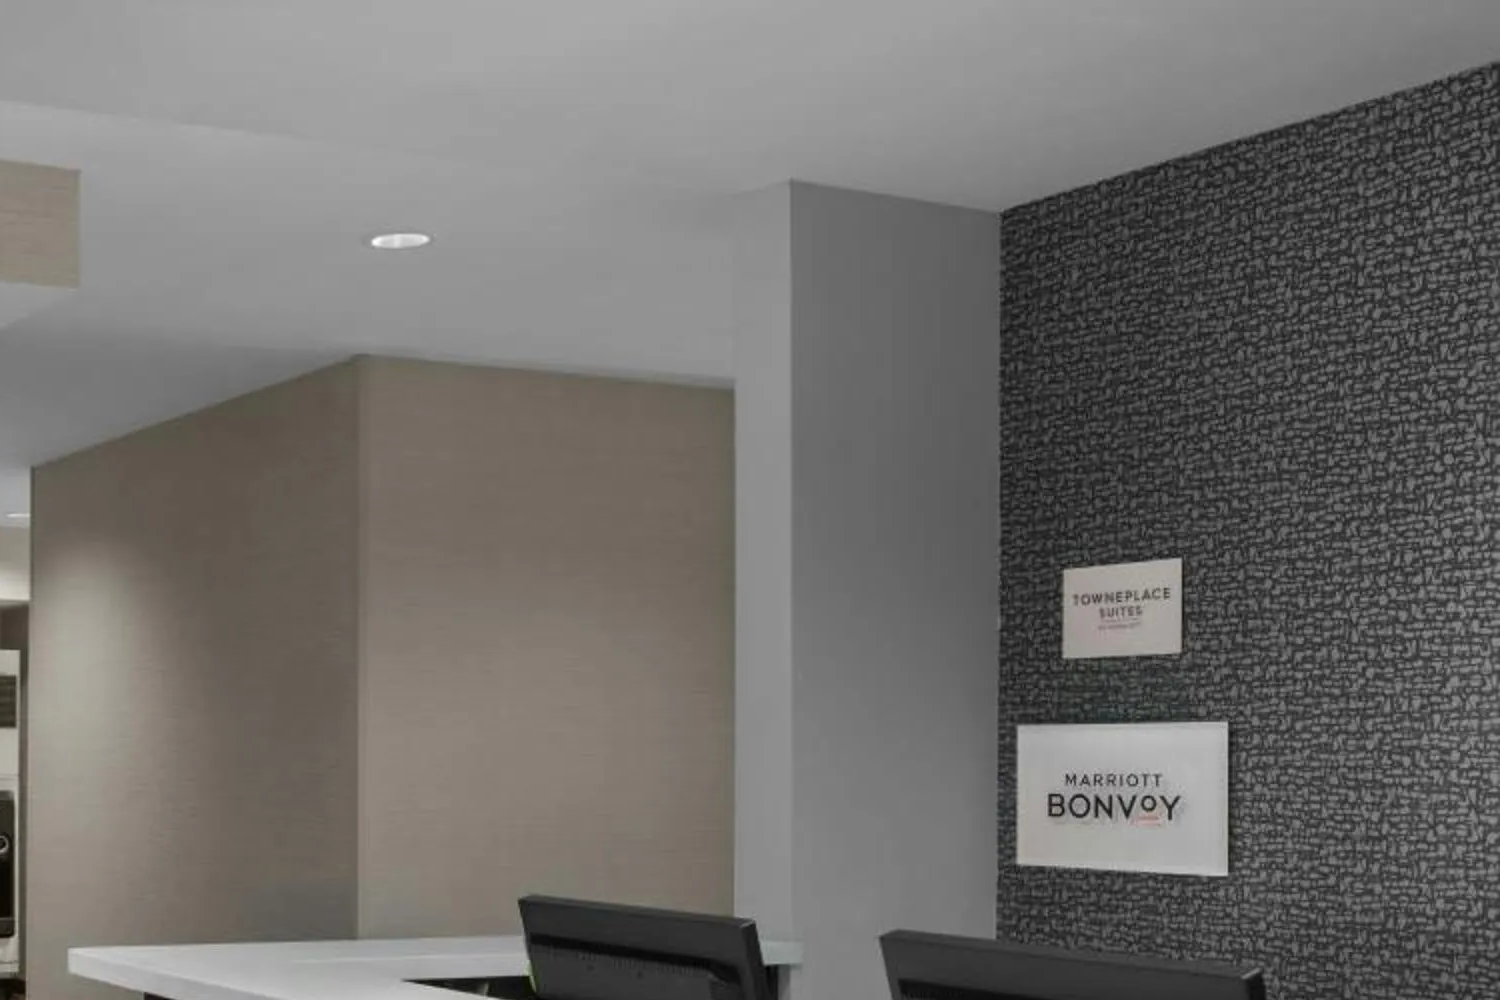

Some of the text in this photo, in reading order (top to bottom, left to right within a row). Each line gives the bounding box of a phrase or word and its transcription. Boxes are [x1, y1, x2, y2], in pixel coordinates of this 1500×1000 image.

[1073, 587, 1171, 606] TOWNEPLACE
[1099, 605, 1143, 619] SUITES
[1064, 772, 1164, 788] MARRIOTT
[1046, 793, 1182, 821] BONVOY
